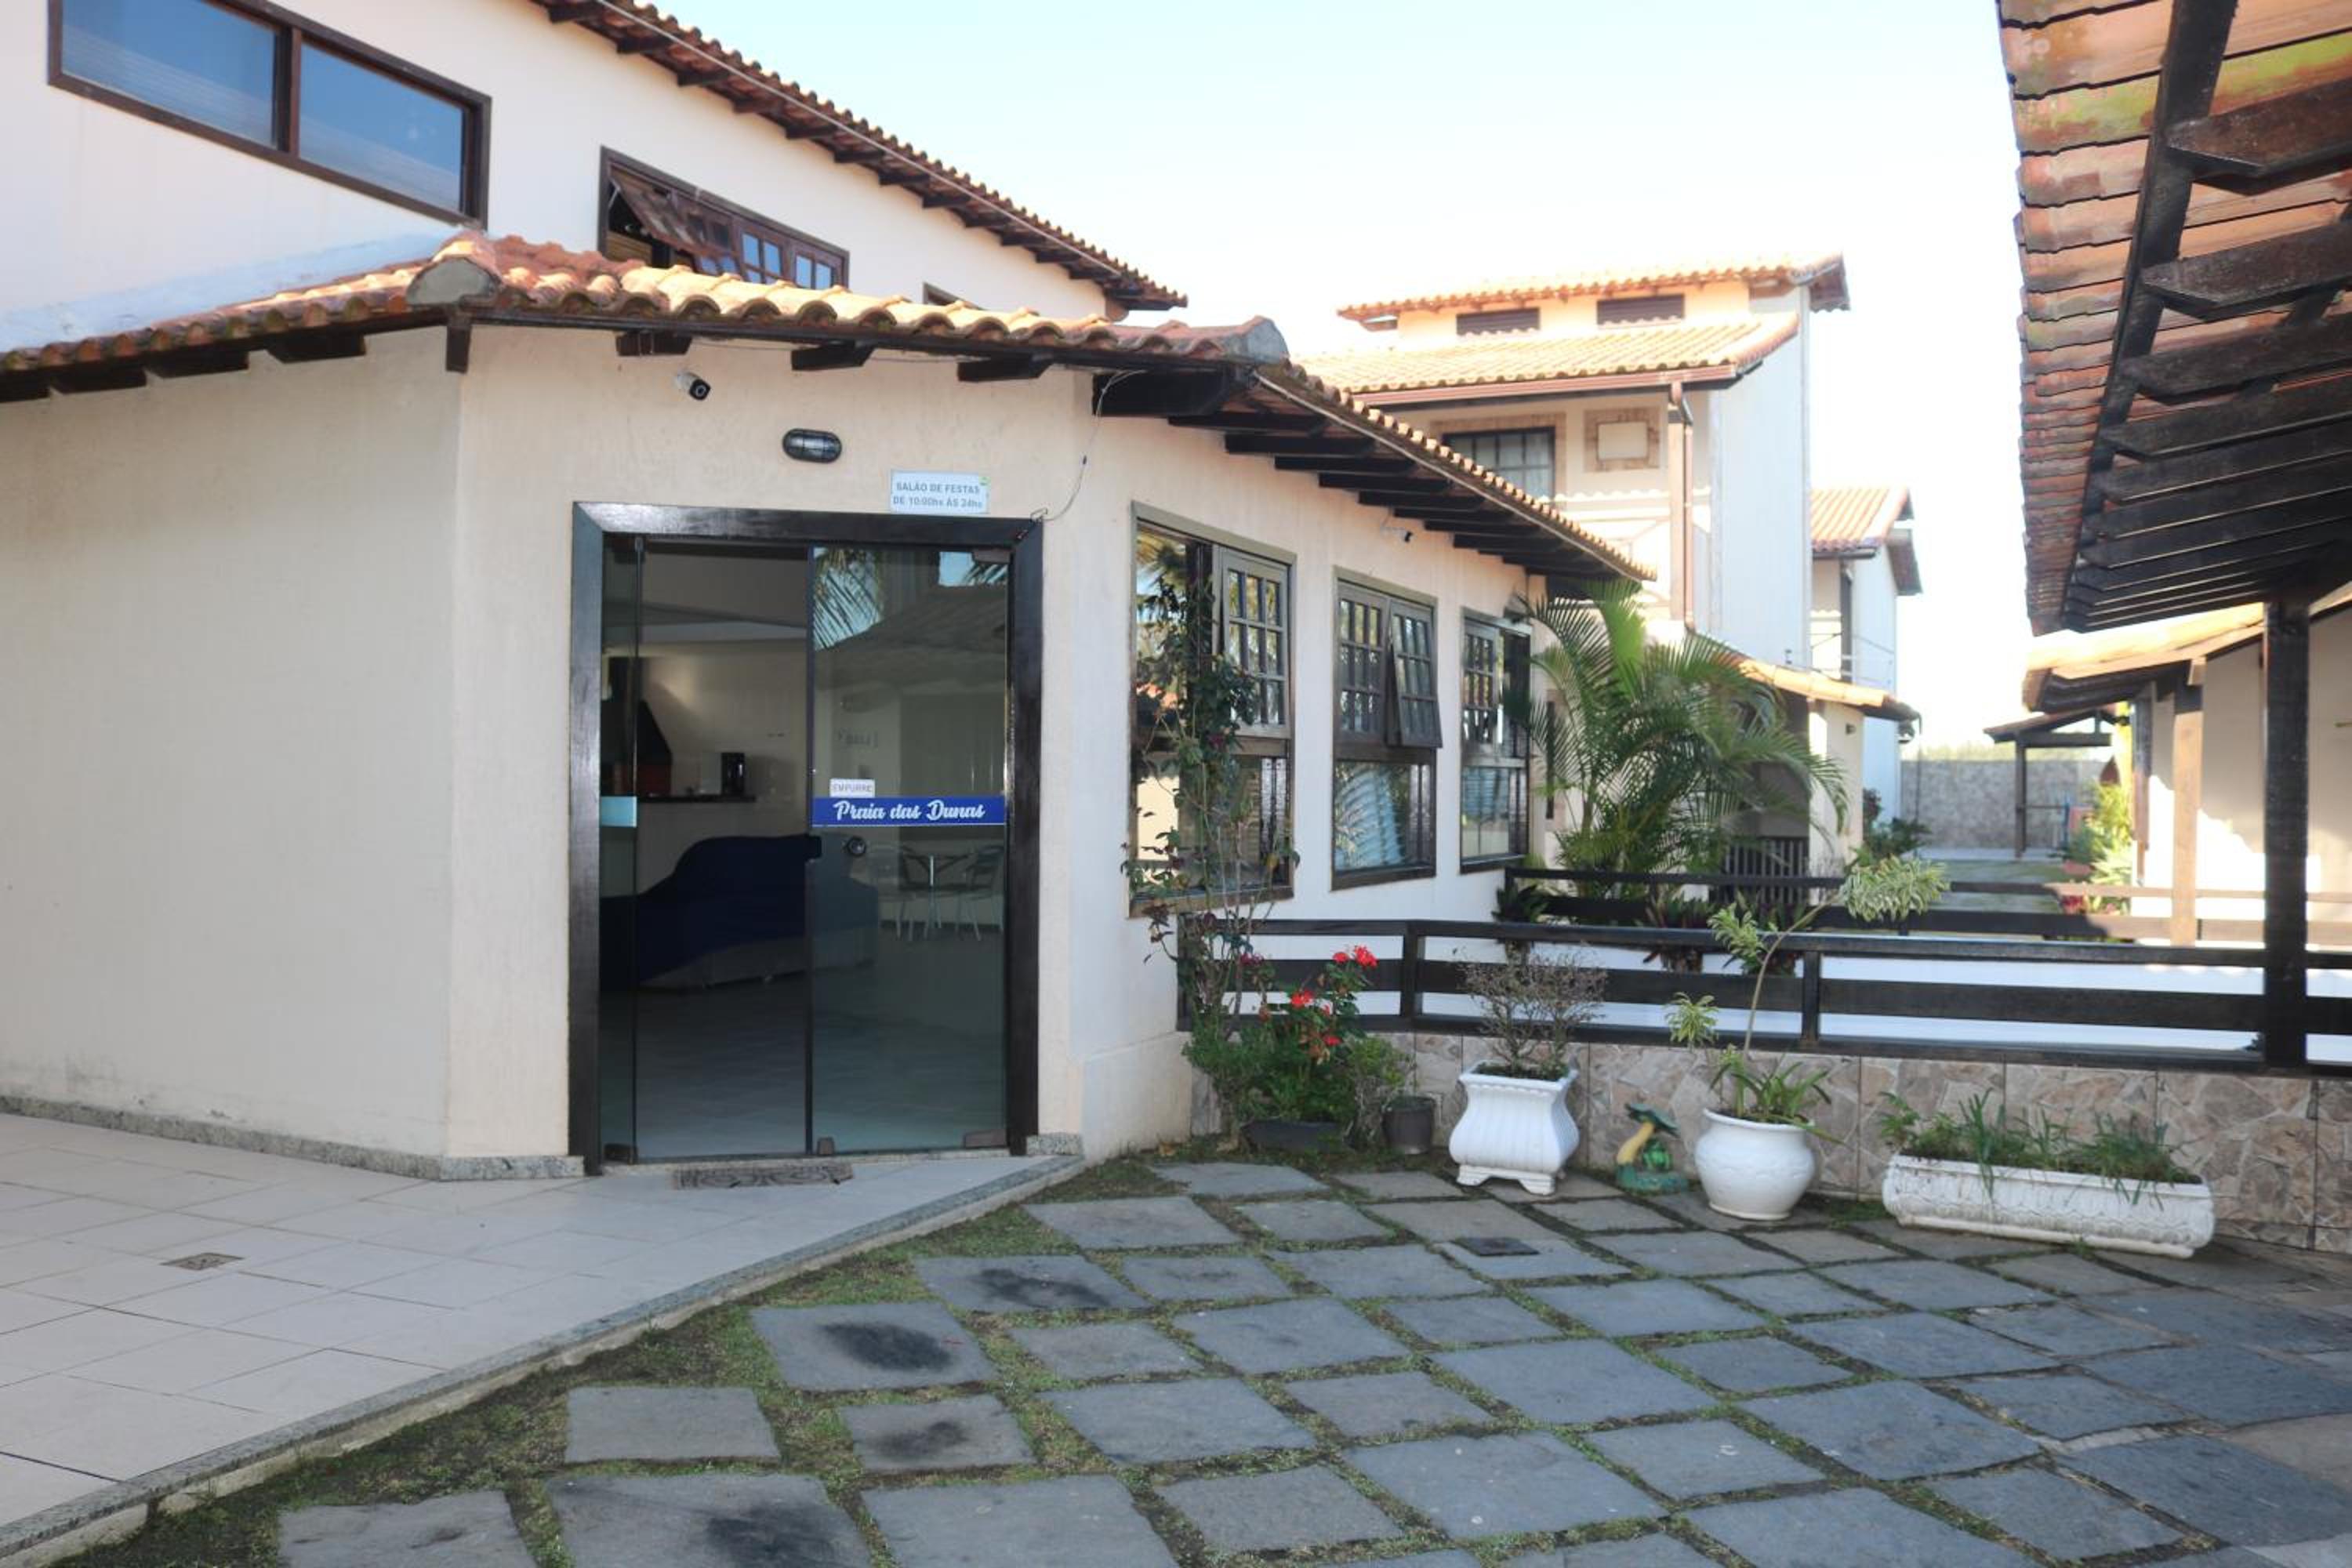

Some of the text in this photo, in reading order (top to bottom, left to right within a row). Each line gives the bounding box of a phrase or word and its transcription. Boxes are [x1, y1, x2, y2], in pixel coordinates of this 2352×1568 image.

[930, 484, 943, 492] DE
[944, 485, 980, 494] FESTAS
[893, 495, 905, 504] DE
[833, 799, 986, 821] Praia das Dunas
